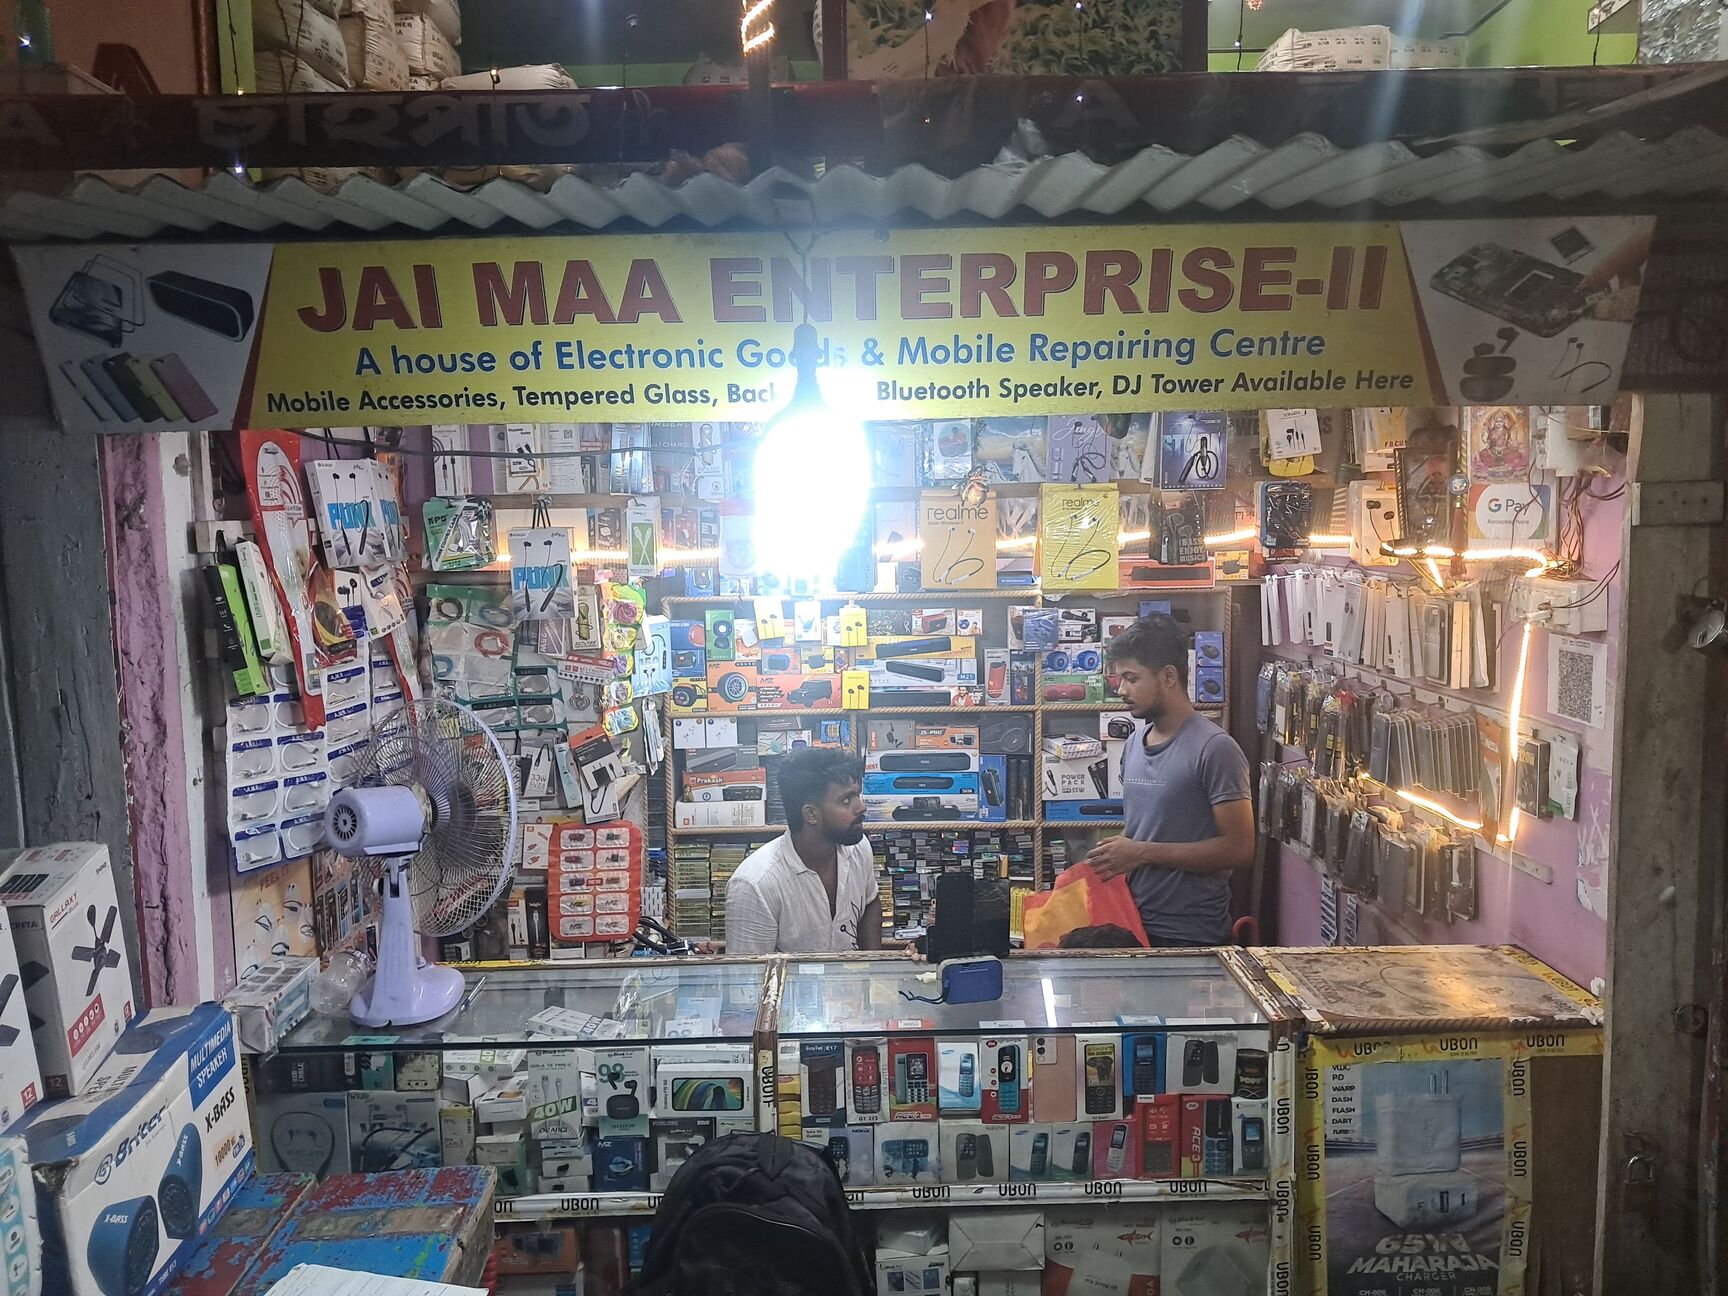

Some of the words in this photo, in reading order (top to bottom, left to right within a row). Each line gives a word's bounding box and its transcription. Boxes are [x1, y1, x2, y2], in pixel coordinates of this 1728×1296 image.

[297, 263, 443, 333] JAI
[471, 258, 684, 327] MAA
[708, 245, 1388, 323] ENTERPRISE-II
[355, 346, 382, 376] A
[390, 344, 497, 375] house
[509, 340, 543, 371] of
[555, 338, 724, 371] Electronic
[861, 337, 885, 366] &
[897, 333, 1016, 366] Mobile
[1029, 329, 1196, 368] Repairing
[1209, 327, 1326, 357] Centre
[266, 390, 351, 414] Mobile
[358, 386, 507, 412] Accessories,
[512, 383, 636, 411] Tempered
[644, 382, 719, 408] Glass,
[877, 377, 990, 402] Bluetooth
[998, 375, 1103, 404] Speaker,
[1112, 374, 1142, 396] DJ
[1150, 373, 1225, 395] Tower
[1231, 369, 1347, 393] Available
[1355, 369, 1414, 391] Here
[927, 504, 989, 521] realme
[1488, 498, 1502, 513] G
[1506, 498, 1530, 515] Pay
[190, 1019, 232, 1073] MULTIMEDIA
[1439, 1037, 1478, 1051] UBON
[1526, 1034, 1565, 1048] UBON
[196, 1047, 228, 1090] SPEAKER
[1331, 1085, 1356, 1093] WARP
[204, 1086, 236, 1135] X-BASS
[534, 1097, 575, 1120] 40W
[1277, 1097, 1290, 1135] UBON
[1331, 1106, 1356, 1114] FLASH
[1331, 1117, 1353, 1125] DART
[1192, 1126, 1200, 1152] ACE
[1306, 1144, 1320, 1181] UBON
[1512, 1141, 1527, 1178] UBON
[1084, 1181, 1122, 1195] UBON
[561, 1198, 600, 1212] UBON
[104, 1213, 128, 1225] X-BASS
[1308, 1225, 1322, 1261] UBON
[1508, 1220, 1525, 1258] UBON
[1347, 1255, 1500, 1275] MAHARAJA
[1396, 1272, 1457, 1282] CHARGER
